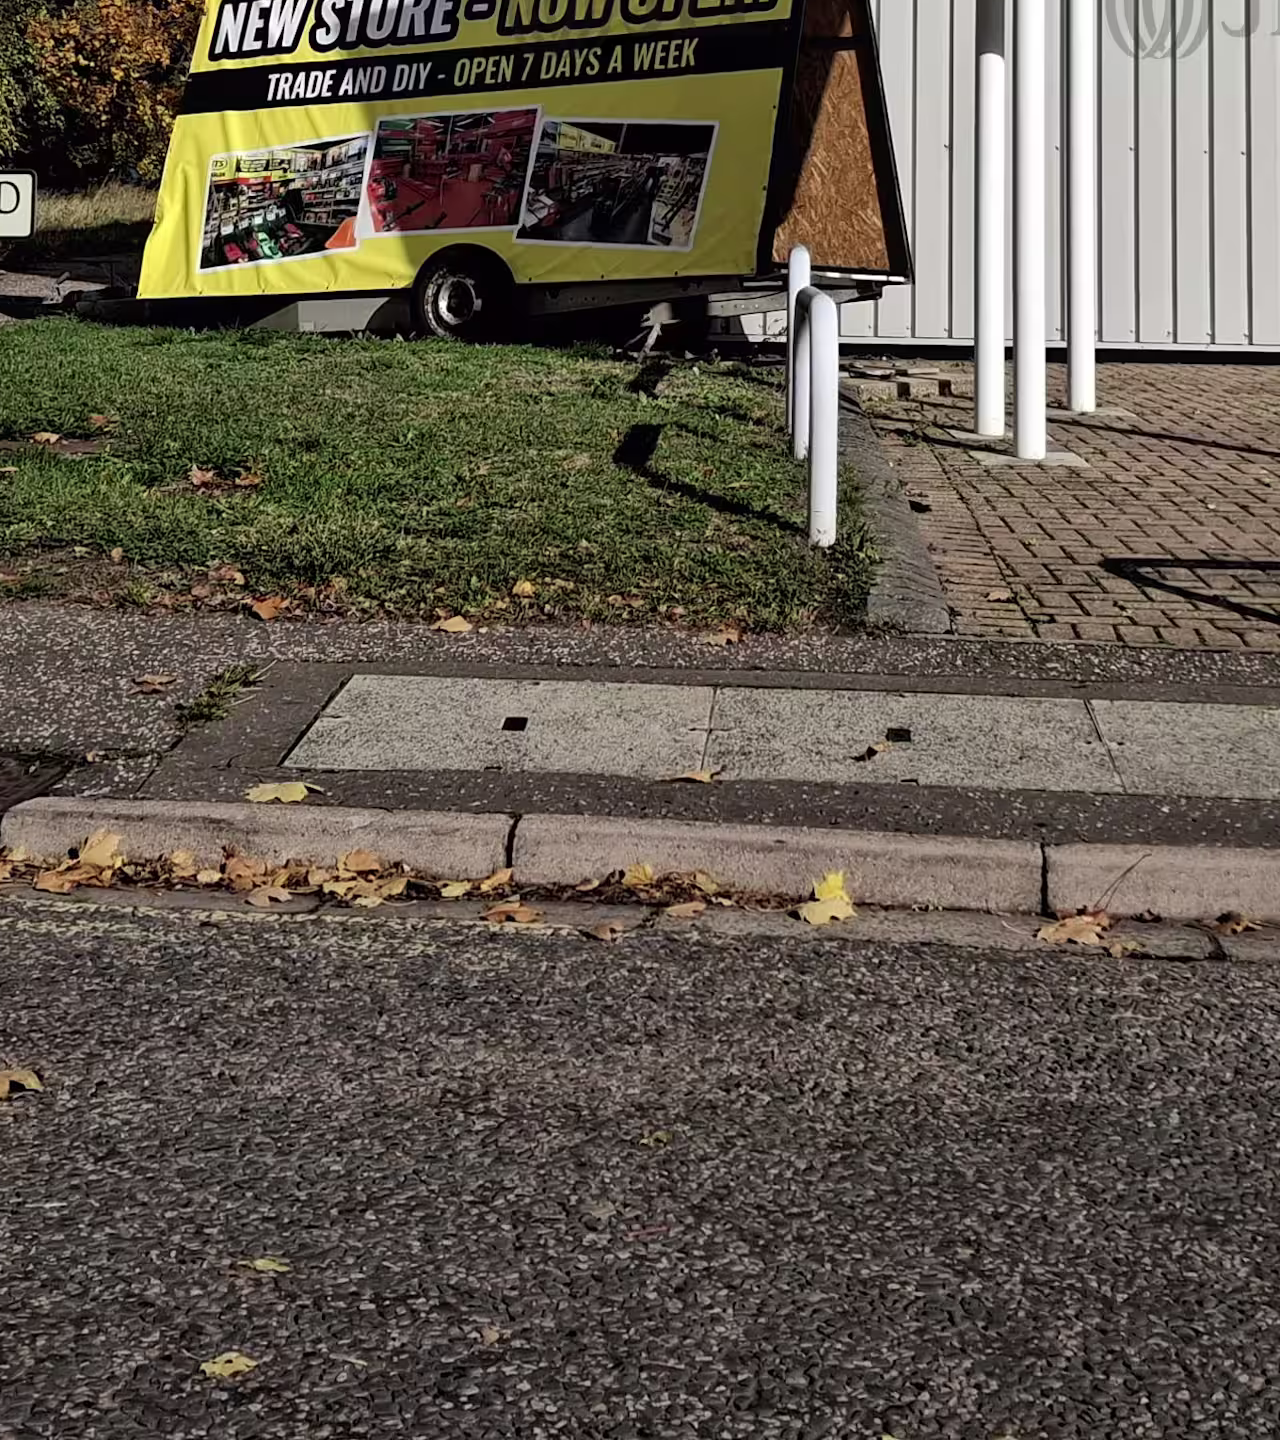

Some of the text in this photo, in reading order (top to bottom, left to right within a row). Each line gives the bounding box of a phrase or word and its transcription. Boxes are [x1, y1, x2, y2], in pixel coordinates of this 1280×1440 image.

[267, 69, 337, 101] TRADE
[338, 65, 387, 96] AND
[392, 62, 432, 92] DIY
[453, 53, 514, 87] OPEN
[520, 53, 534, 81] 7
[540, 47, 602, 79] DAYS
[607, 45, 623, 73] A
[632, 37, 699, 72] WEEK
